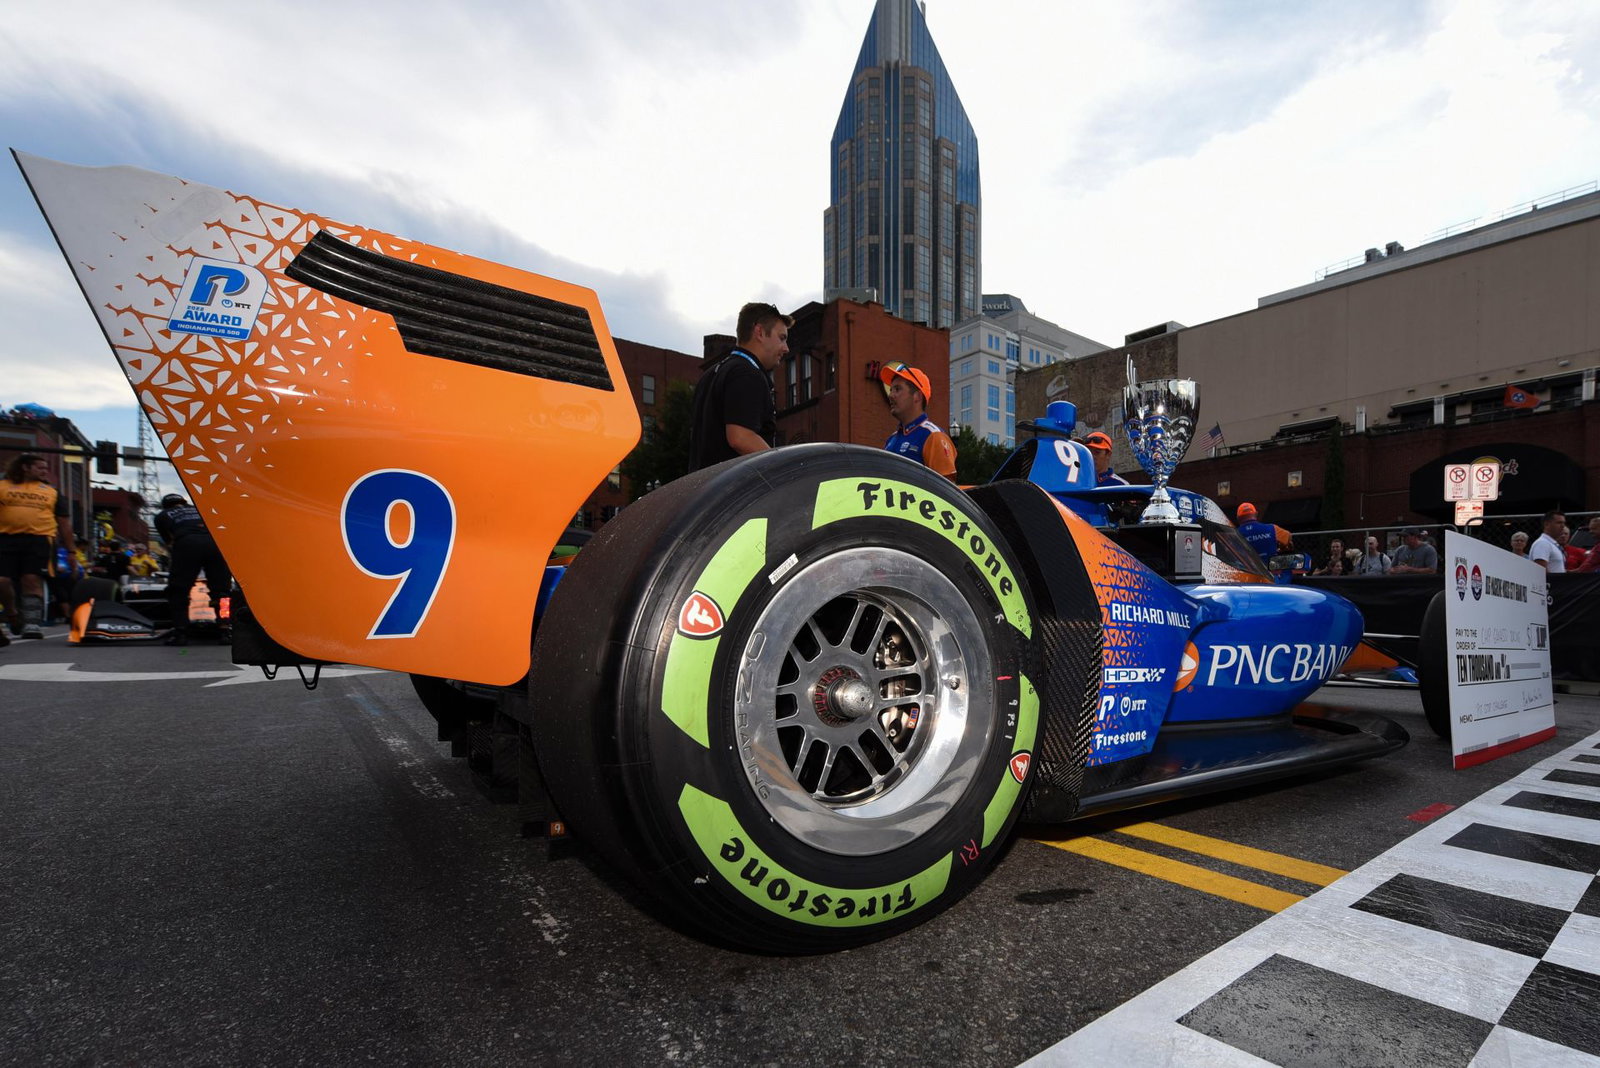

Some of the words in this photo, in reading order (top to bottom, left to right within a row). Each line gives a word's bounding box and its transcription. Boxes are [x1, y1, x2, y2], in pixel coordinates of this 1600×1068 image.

[234, 301, 251, 310] NTT
[182, 310, 242, 327] AWARD
[177, 323, 226, 334] INDIANAPOLIS
[1053, 439, 1081, 483] 9
[857, 482, 1013, 597] Firestone
[340, 468, 457, 640] 9
[1111, 602, 1165, 625] RICHARD
[1166, 611, 1191, 629] MILLE
[1455, 628, 1464, 638] PAY
[1464, 629, 1470, 638] TO
[1470, 629, 1478, 638] THE
[1456, 641, 1470, 650] ORDER
[1470, 641, 1476, 650] OF
[1106, 670, 1139, 681] HPD
[1456, 654, 1468, 683] TEN
[1468, 654, 1494, 682] THOUSAND
[1131, 699, 1147, 711] NTT
[1459, 713, 1473, 724] MEMO
[1095, 730, 1147, 751] Firestone
[737, 712, 771, 801] RACING
[719, 837, 918, 920] Firestone
